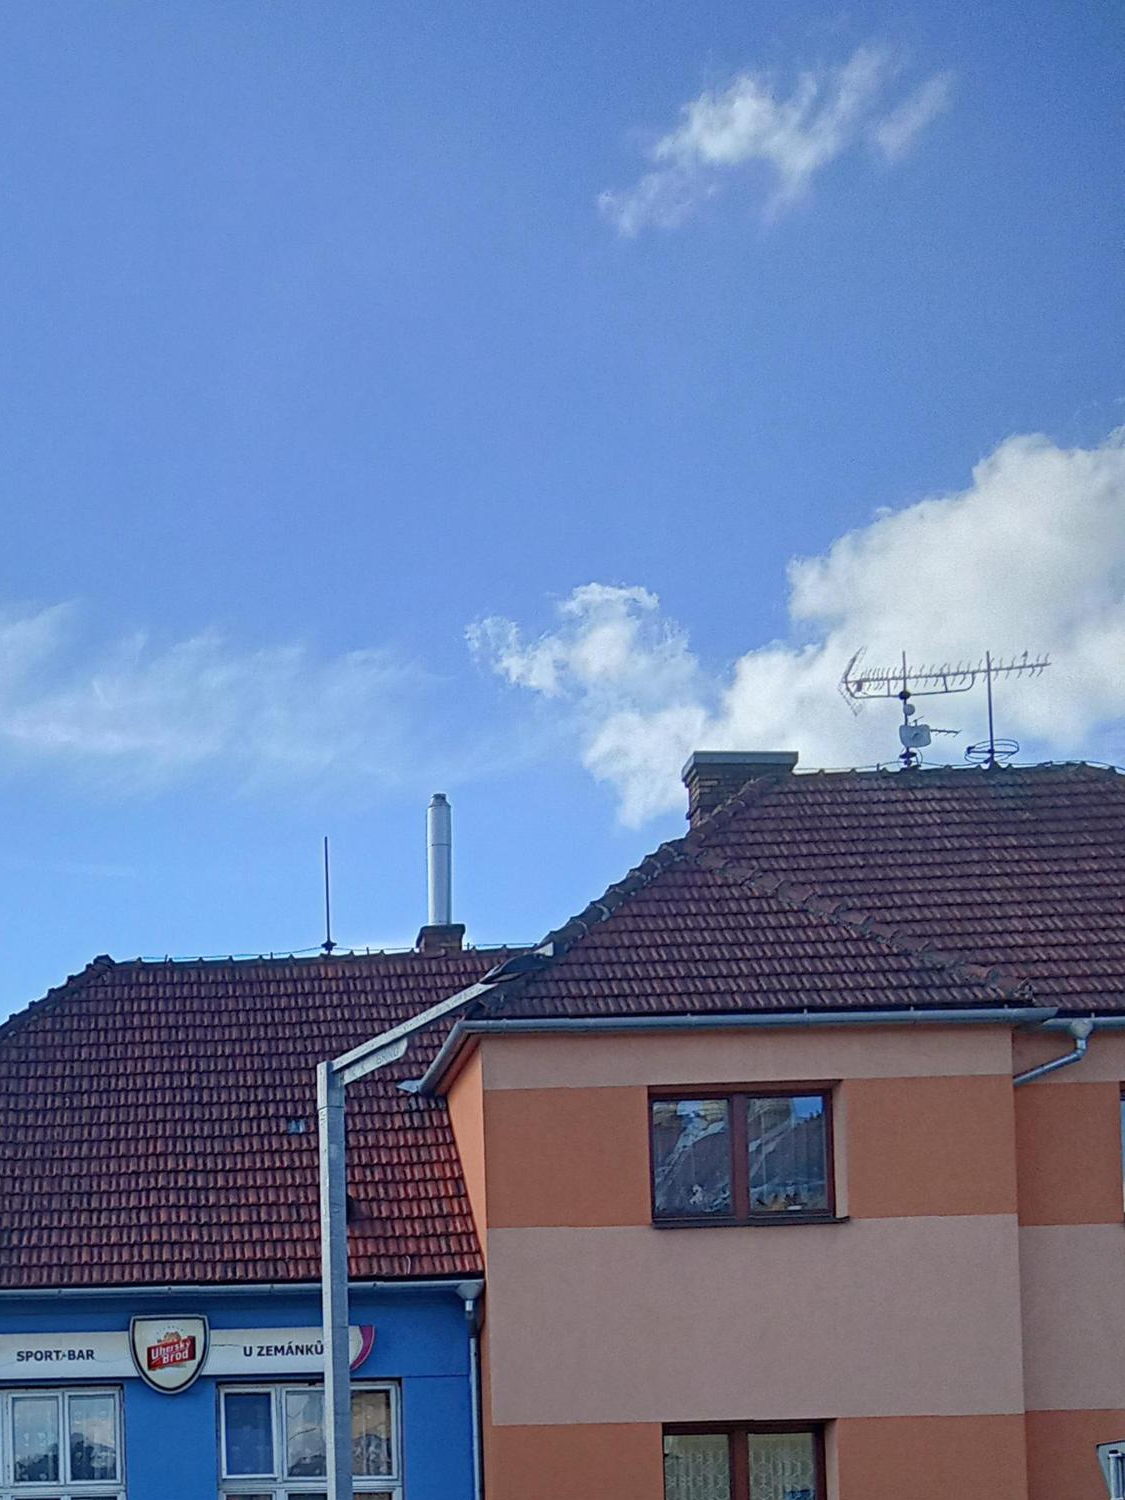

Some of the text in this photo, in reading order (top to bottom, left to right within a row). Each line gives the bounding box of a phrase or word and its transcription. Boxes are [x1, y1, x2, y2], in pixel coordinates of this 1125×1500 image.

[162, 1349, 190, 1364] Brod
[243, 1340, 325, 1357] U ZEMÁNKŮ
